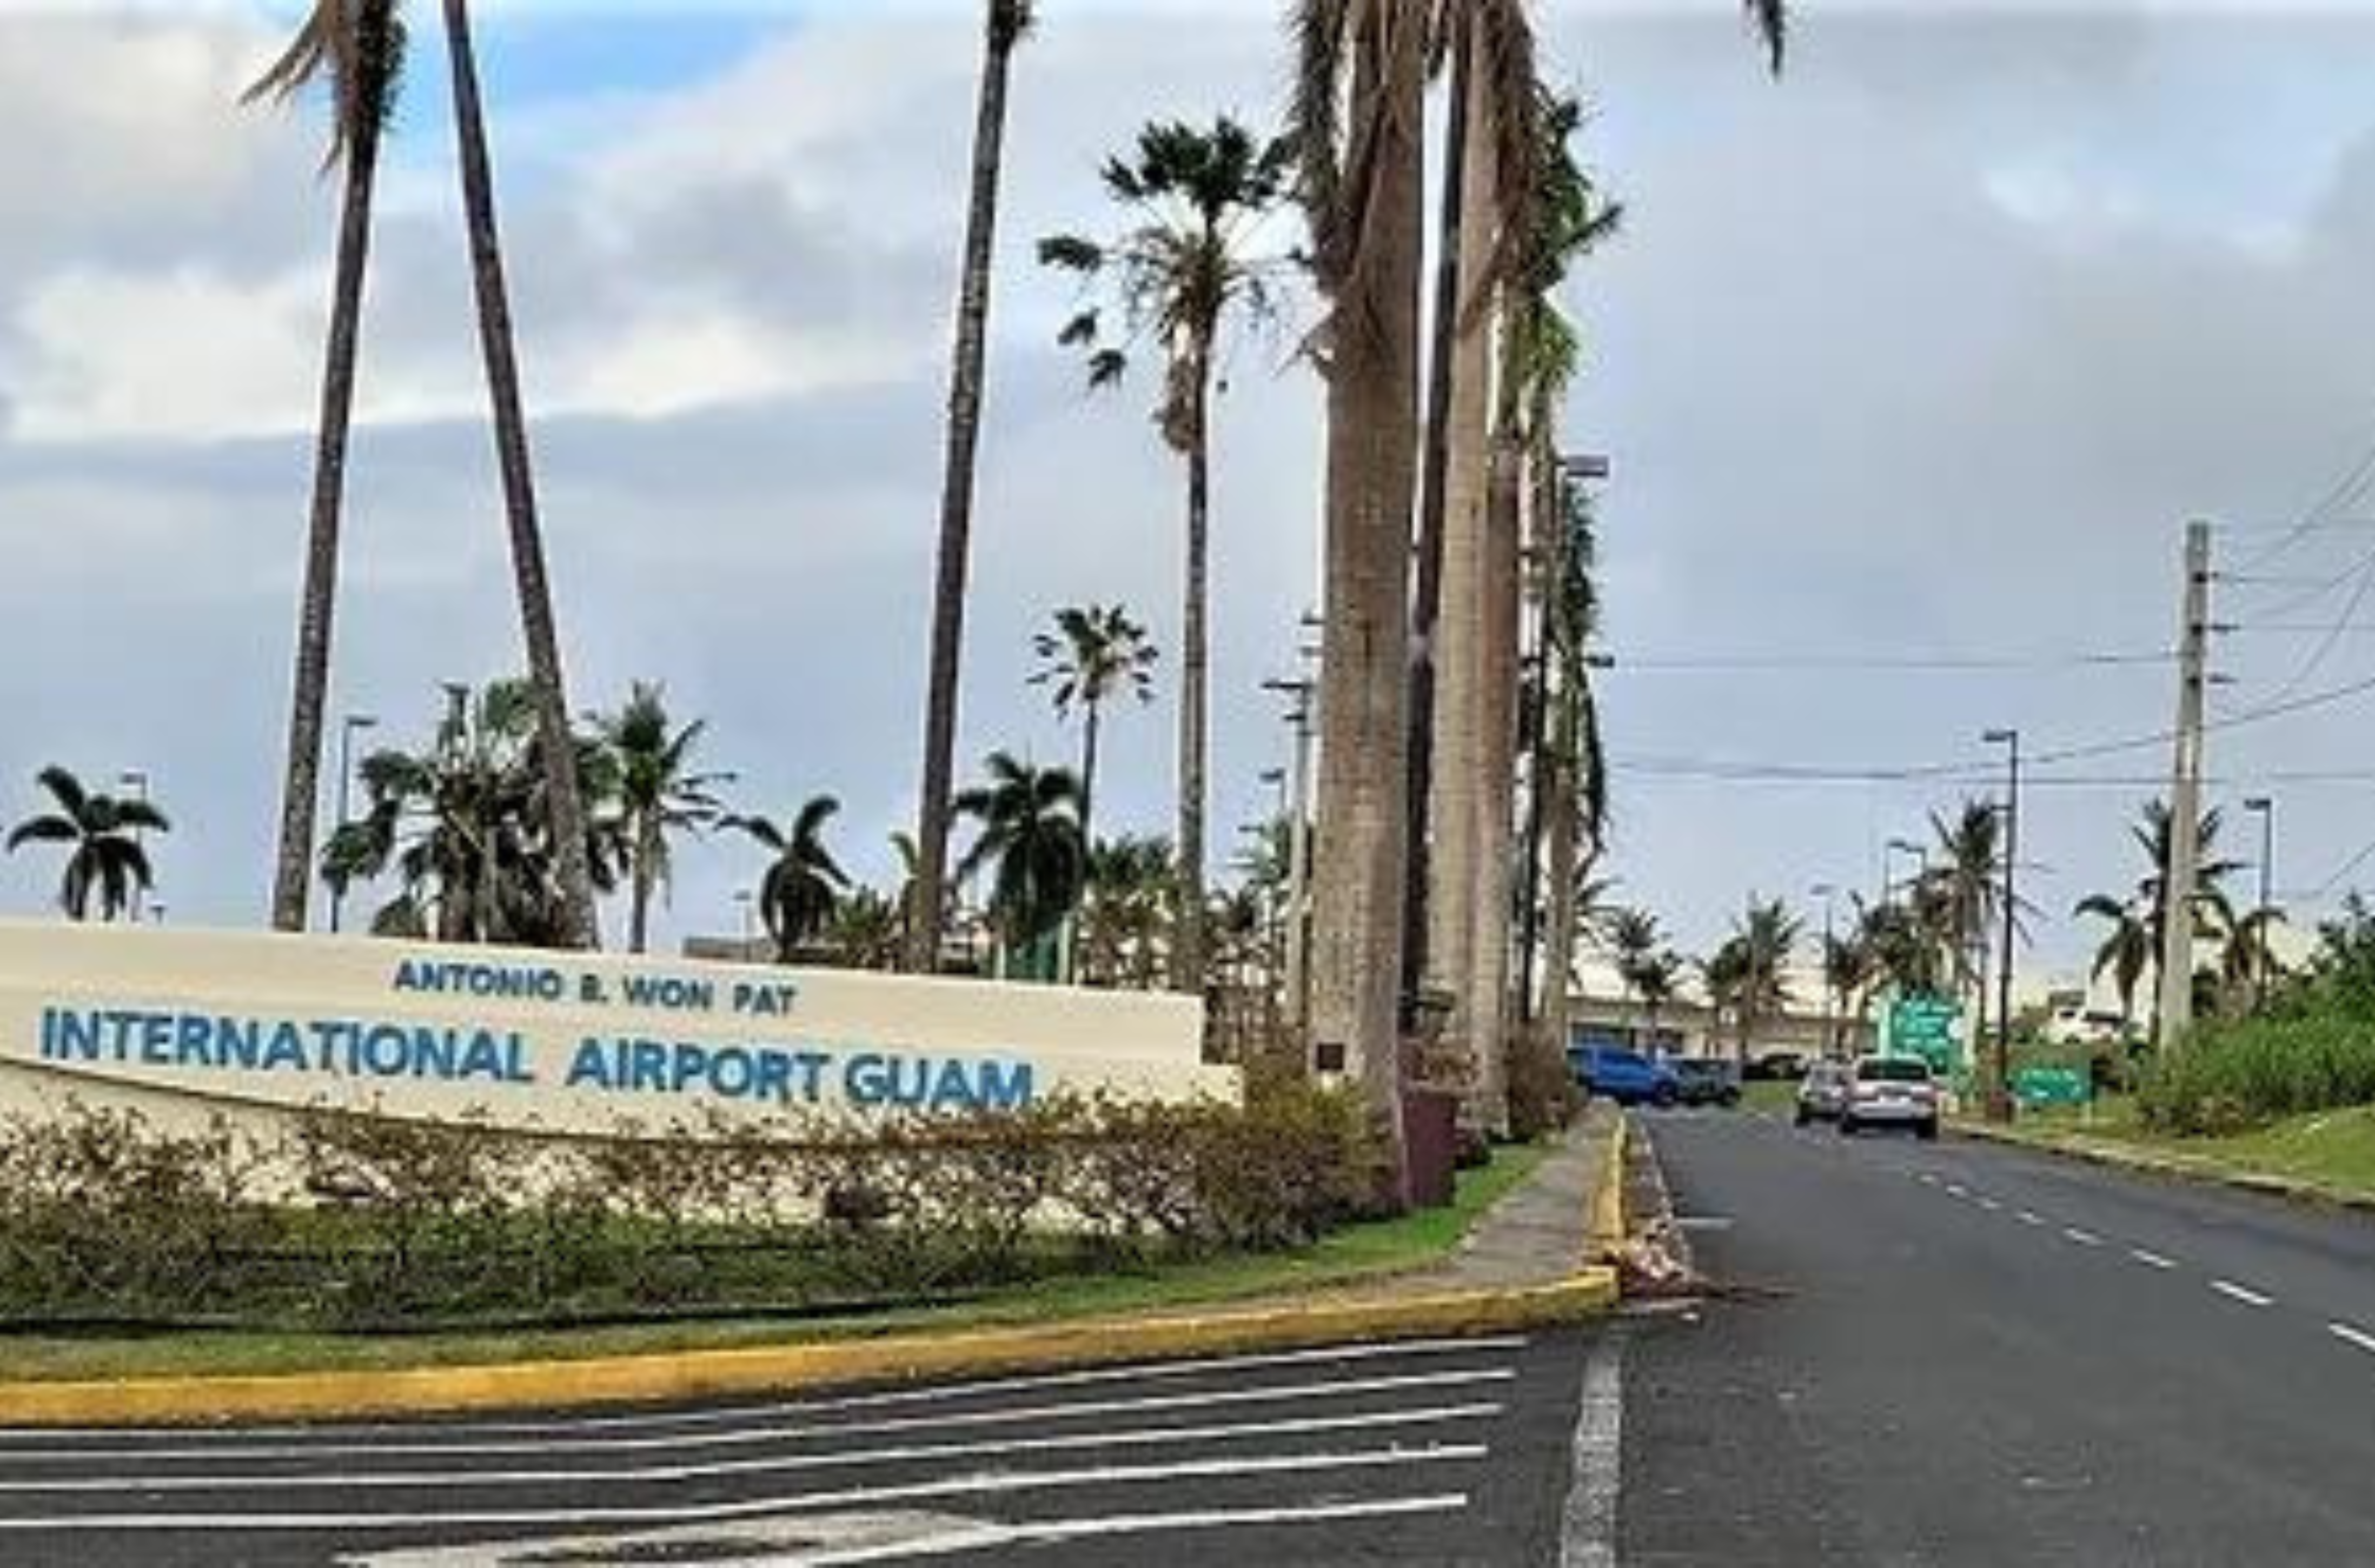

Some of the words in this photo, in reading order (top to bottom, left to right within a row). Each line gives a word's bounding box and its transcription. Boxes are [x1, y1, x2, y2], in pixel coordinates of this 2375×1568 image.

[394, 960, 563, 1002] ANTONIO
[580, 975, 609, 1004] B.
[622, 978, 712, 1012] WON
[733, 984, 795, 1016] PAT
[39, 1007, 535, 1082] INTERNATIONAL
[565, 1037, 830, 1102] AIRPORT
[845, 1053, 1033, 1110] GUAM
